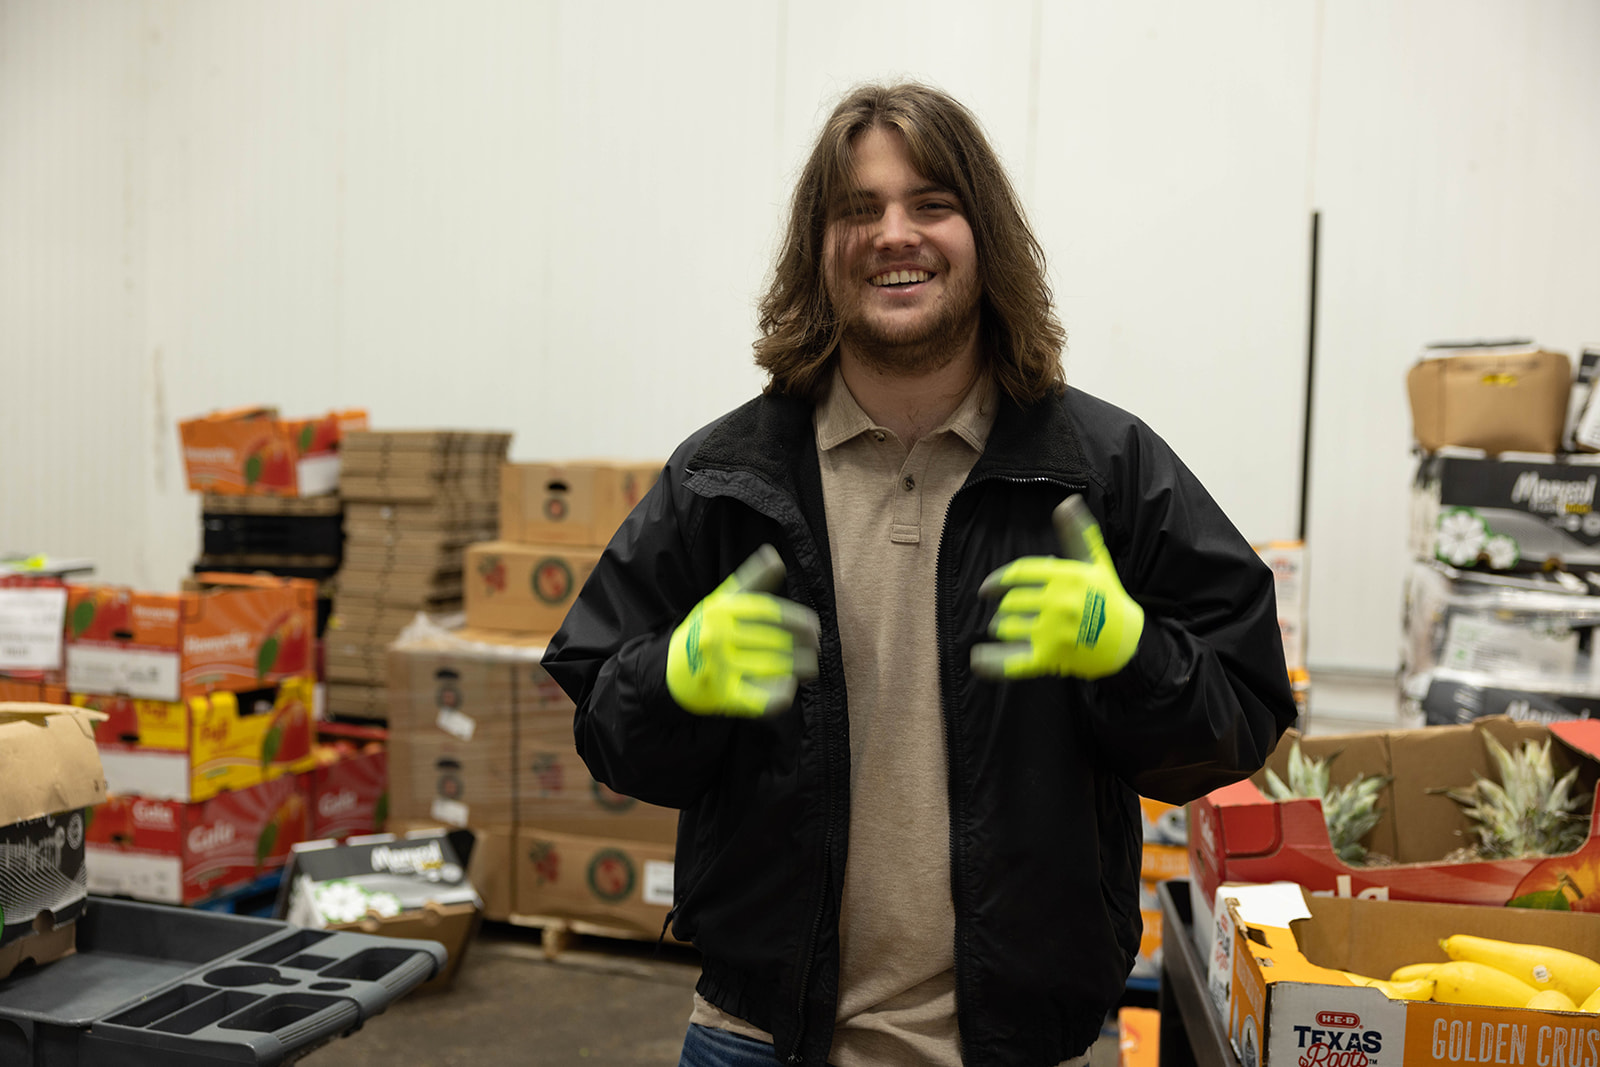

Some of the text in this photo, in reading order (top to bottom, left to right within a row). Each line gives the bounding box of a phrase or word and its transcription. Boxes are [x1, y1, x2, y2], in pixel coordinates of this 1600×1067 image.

[1294, 1025, 1382, 1054] TEXAS
[1432, 1018, 1600, 1067] GOLDEN CRUS
[1299, 1042, 1369, 1067] Roots
